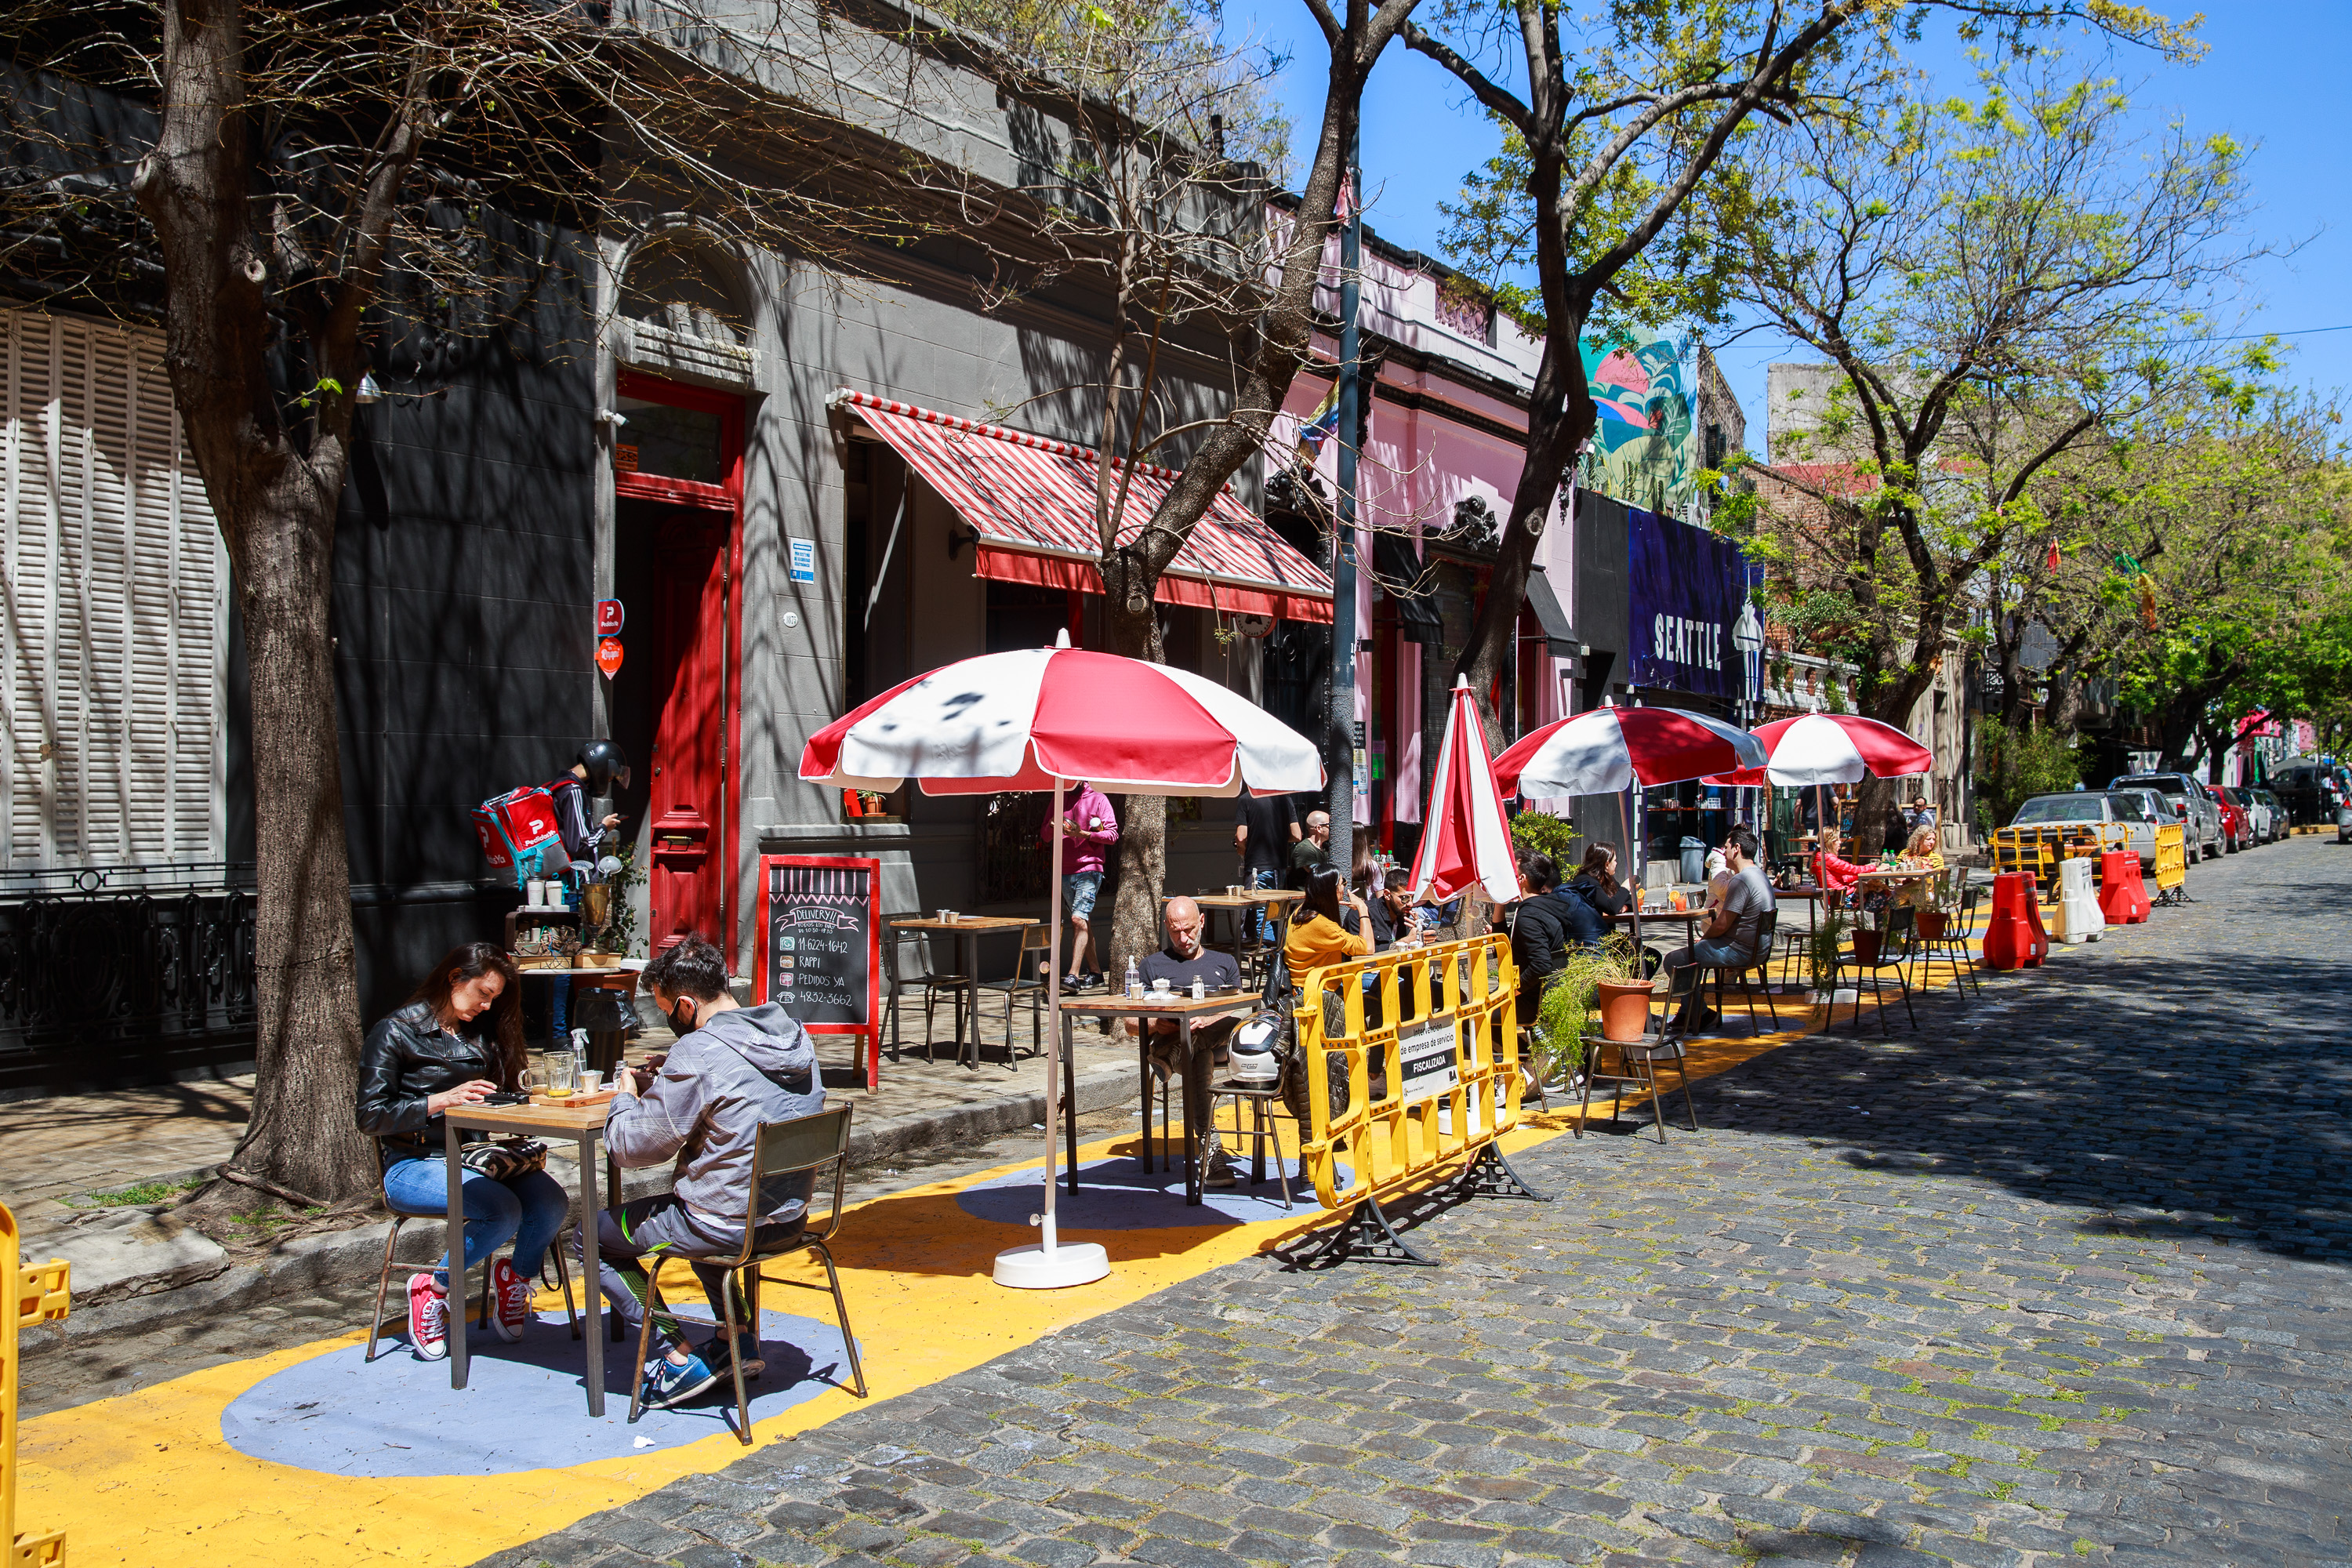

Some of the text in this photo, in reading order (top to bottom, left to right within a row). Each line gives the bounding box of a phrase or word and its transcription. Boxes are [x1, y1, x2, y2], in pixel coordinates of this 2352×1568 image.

[1654, 613, 1721, 670] SEATTLE
[524, 829, 556, 847] PedidosYa
[797, 909, 837, 923] DELIVERY!!
[799, 956, 821, 969] RAPPI
[797, 973, 845, 988] PEDIDOS YA
[800, 990, 852, 1007] 4832-3662
[1413, 1022, 1443, 1037] Intervención
[1400, 1033, 1454, 1055] de empresa de servicio
[1413, 1054, 1446, 1073] FISCALIZADA
